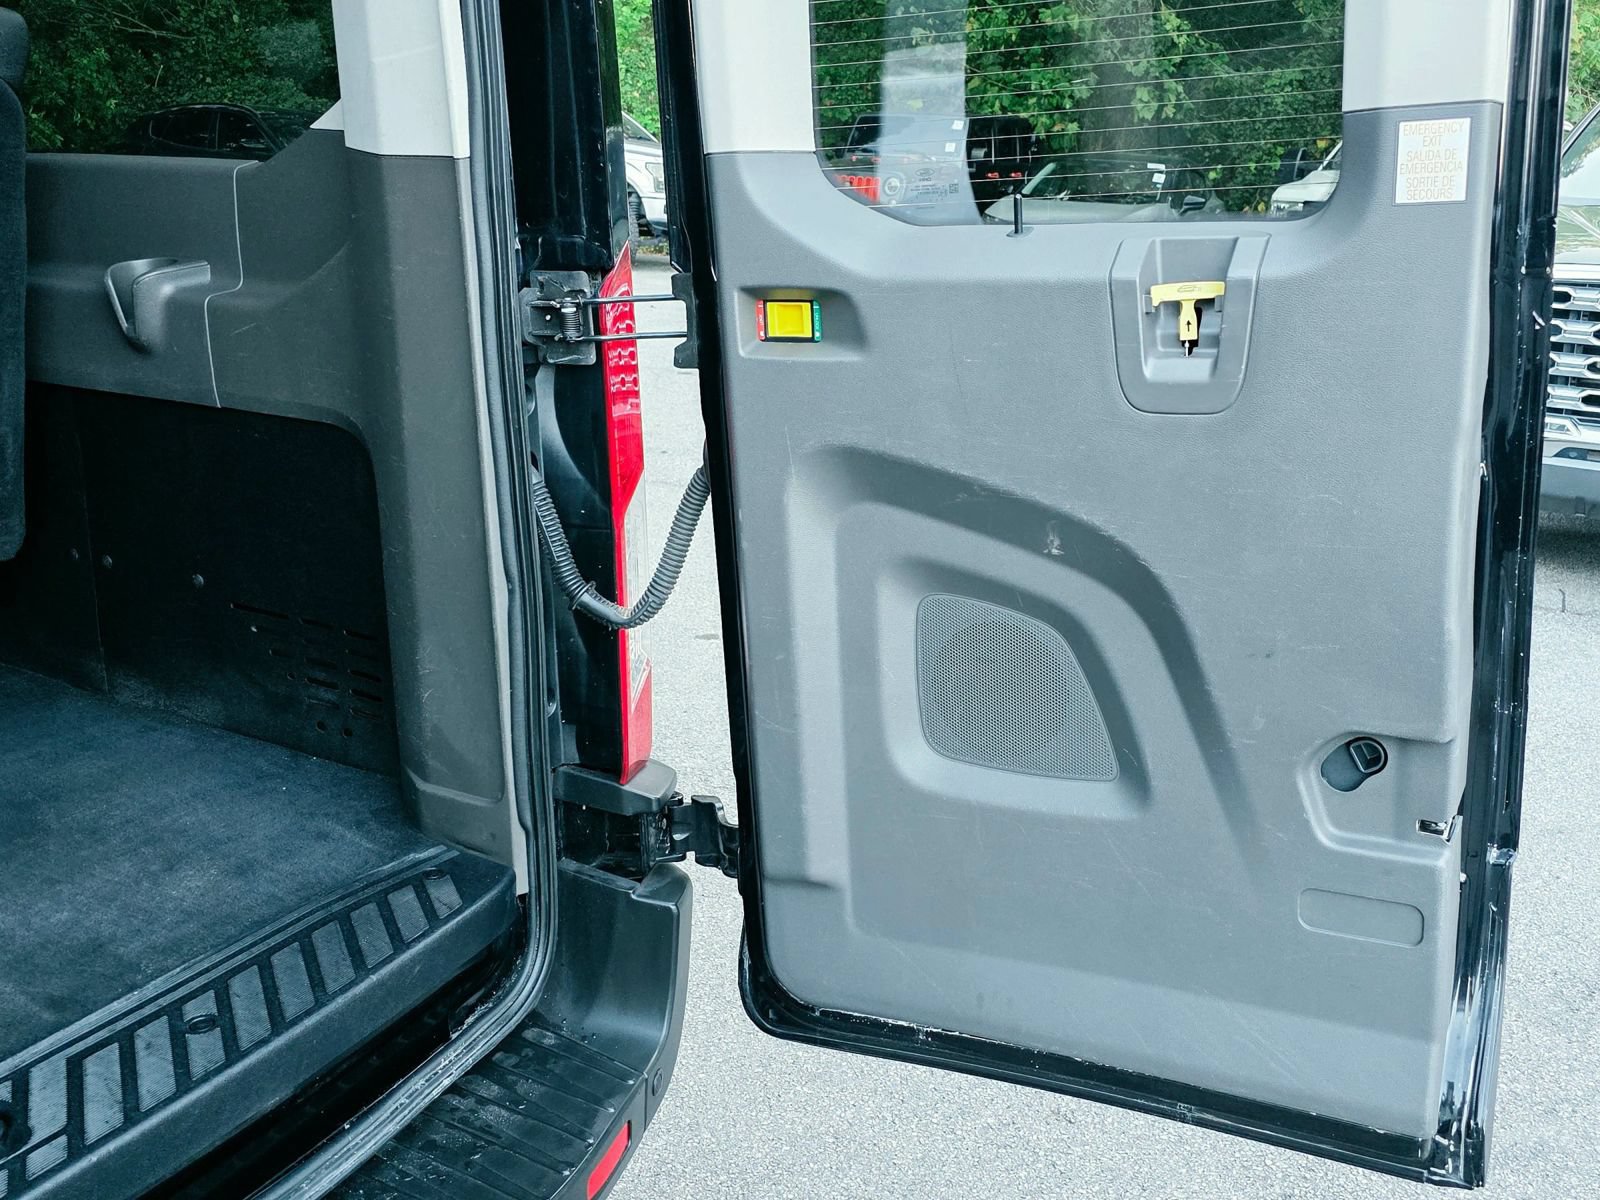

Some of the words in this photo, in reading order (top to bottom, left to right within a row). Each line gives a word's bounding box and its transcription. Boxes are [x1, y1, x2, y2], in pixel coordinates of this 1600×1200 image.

[1403, 121, 1464, 136] EMERGENCY
[1423, 135, 1442, 147] EXIT
[1407, 150, 1441, 162] SALIDA
[1444, 148, 1457, 160] DE
[1400, 161, 1463, 175] EMERGENCIA
[1406, 176, 1439, 189] SORTIE
[1442, 175, 1455, 187] DE
[1407, 187, 1453, 200] SECOURS
